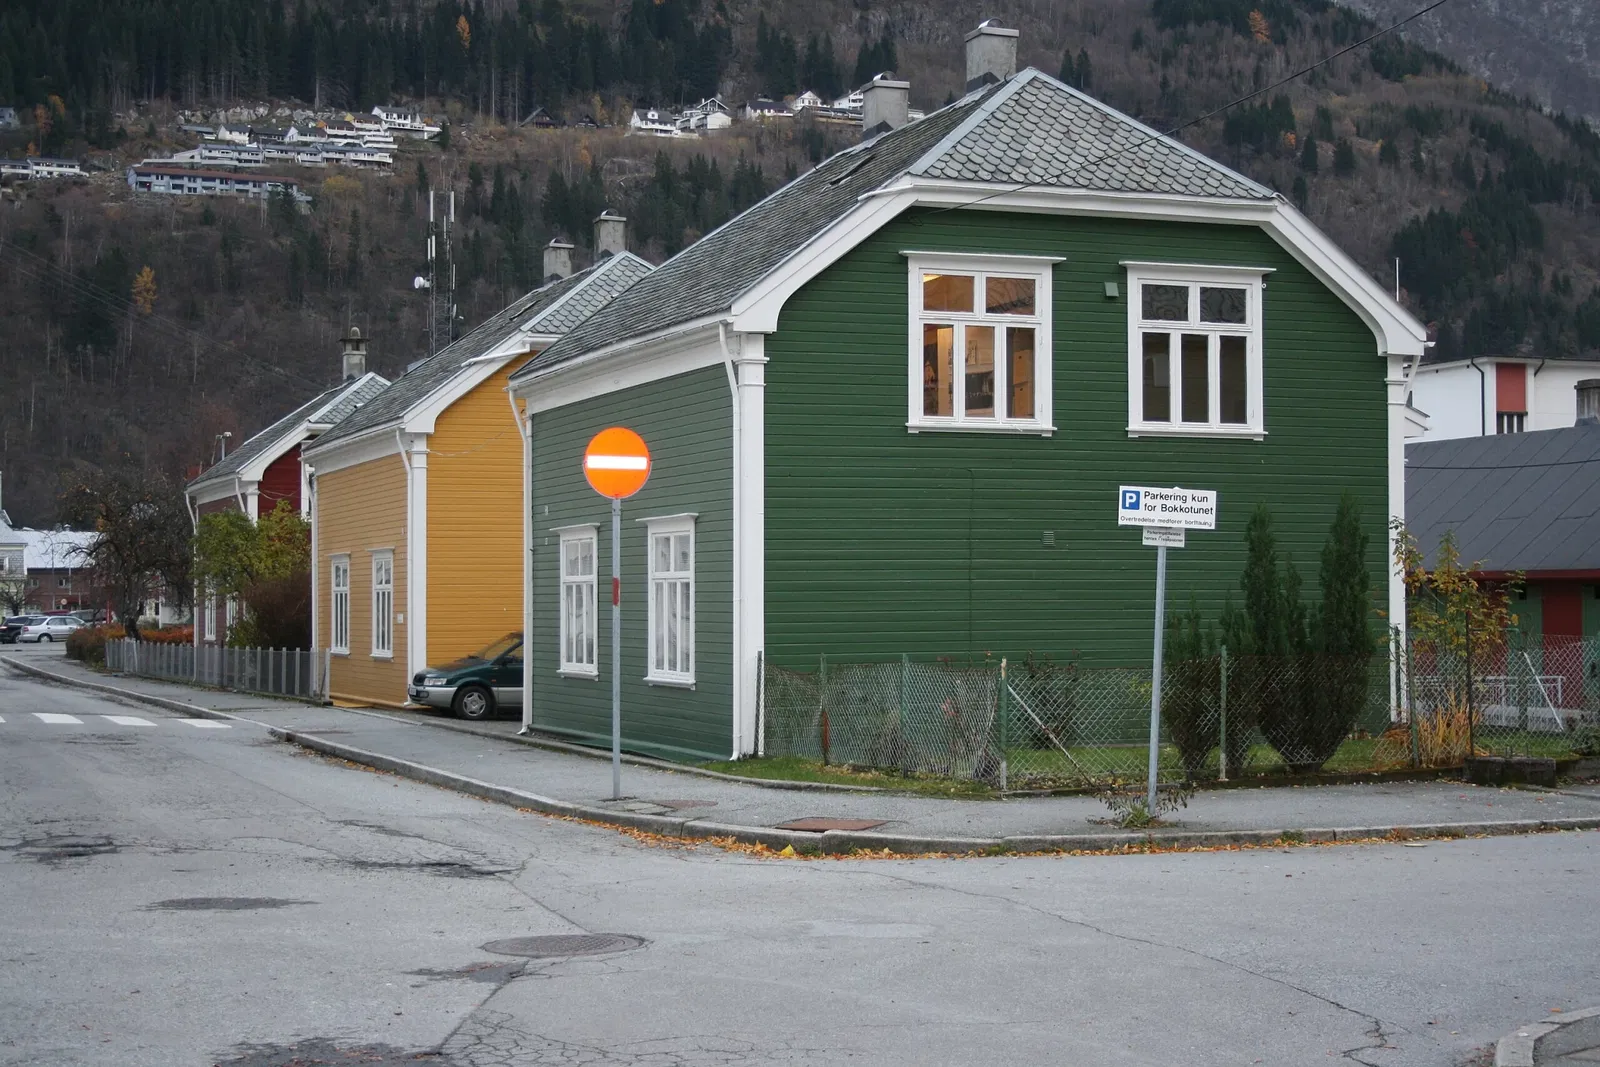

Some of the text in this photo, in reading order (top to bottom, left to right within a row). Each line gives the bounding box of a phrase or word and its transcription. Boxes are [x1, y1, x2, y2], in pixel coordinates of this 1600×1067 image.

[1125, 492, 1137, 508] P
[1144, 491, 1208, 504] Parkering kun
[1144, 503, 1214, 515] for Bokkotunet
[1120, 515, 1156, 523] Overtredelse
